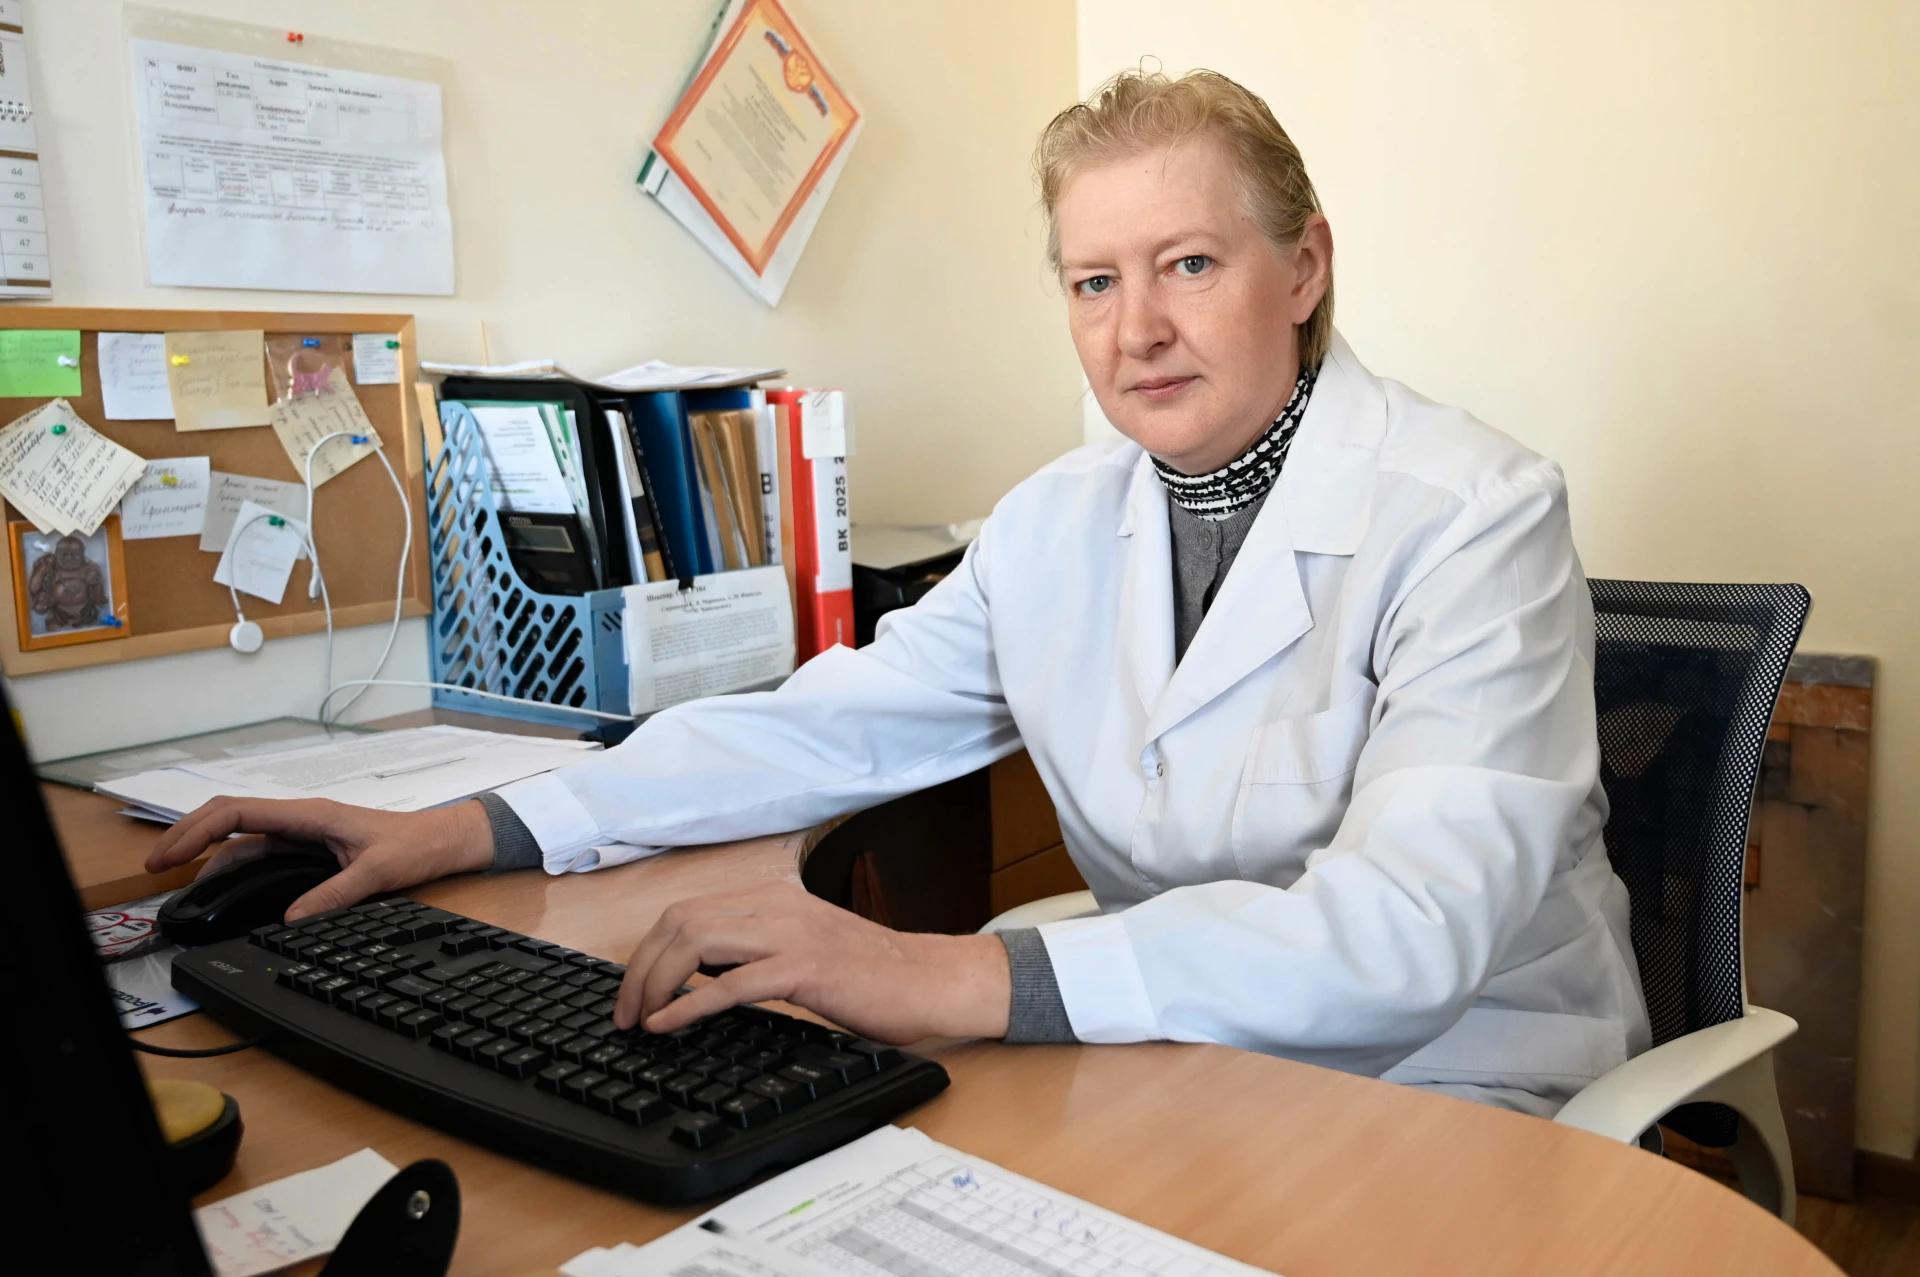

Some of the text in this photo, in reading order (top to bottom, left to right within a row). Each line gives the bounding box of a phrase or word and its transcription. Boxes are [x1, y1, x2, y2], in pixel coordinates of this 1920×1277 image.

[11, 168, 23, 176] 44
[14, 192, 26, 200] 45
[16, 215, 28, 224] 46
[20, 239, 30, 247] 47
[22, 262, 34, 271] 48
[835, 476, 847, 517] 2025
